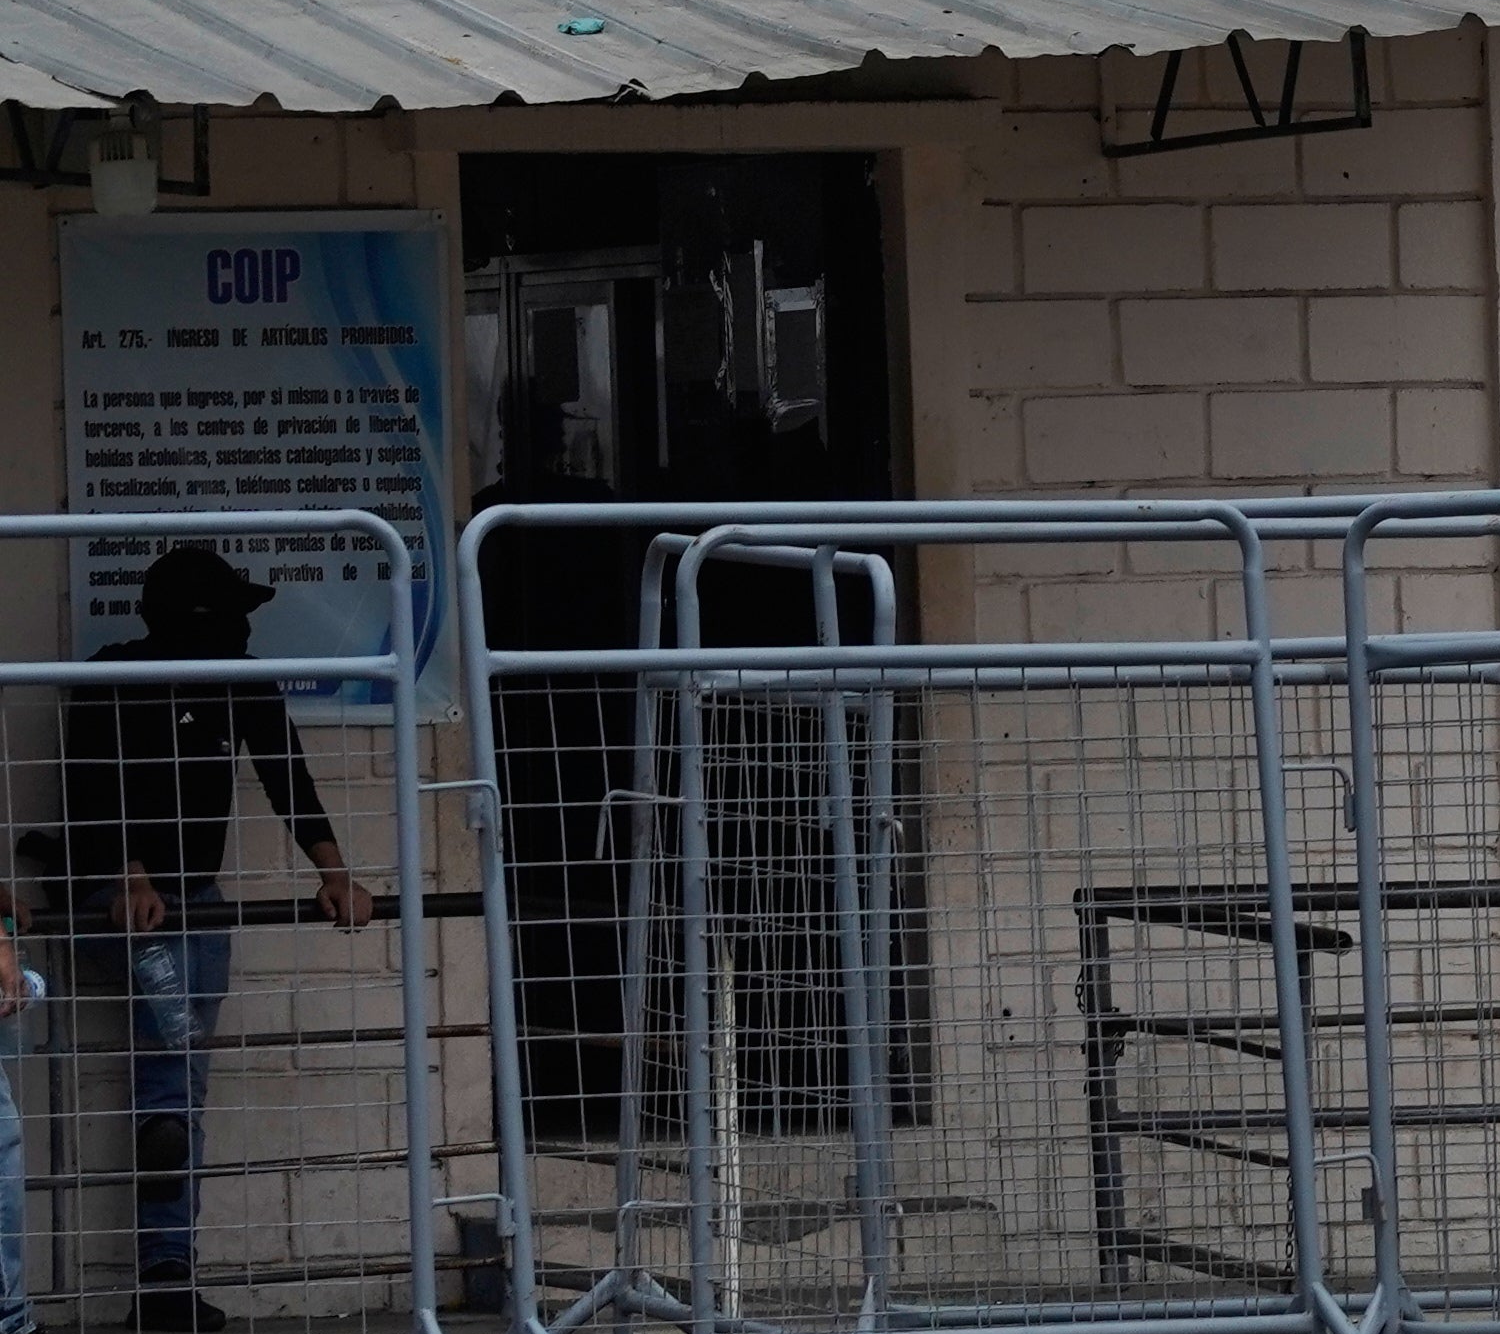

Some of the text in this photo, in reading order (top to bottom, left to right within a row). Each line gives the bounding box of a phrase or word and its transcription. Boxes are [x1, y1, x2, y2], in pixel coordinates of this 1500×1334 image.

[206, 248, 300, 304] COIP
[82, 330, 106, 349] Art.
[166, 328, 219, 348] INGRESO
[232, 328, 248, 347] DE
[261, 323, 328, 347] ARTÍCULOS
[341, 326, 418, 346] PROHIBIDOS.
[84, 390, 98, 408] La
[103, 391, 155, 410] persona
[160, 391, 182, 410] que
[243, 389, 265, 410] por
[288, 387, 328, 405] misma
[334, 389, 341, 404] o
[346, 389, 354, 404] a
[359, 384, 399, 404] través
[405, 386, 420, 403] de
[84, 414, 420, 439] terceros, a los centros de privación de libertad,
[86, 449, 133, 467] bebidas
[216, 447, 281, 465] sustancias
[286, 445, 361, 466] catalogadas
[366, 447, 373, 465] y
[378, 444, 421, 465] sujetas
[87, 473, 422, 498] a fiscalización, armas, teléfonos celulares o equipos
[88, 537, 151, 556] adheridos
[156, 536, 167, 555] al
[223, 538, 230, 554] o
[236, 538, 243, 554] a
[248, 537, 270, 553] sus
[275, 534, 325, 555] prendas
[331, 533, 345, 551] de
[269, 564, 323, 584] privativa
[343, 563, 357, 581] de
[90, 598, 105, 616] de
[109, 599, 130, 616] uno
